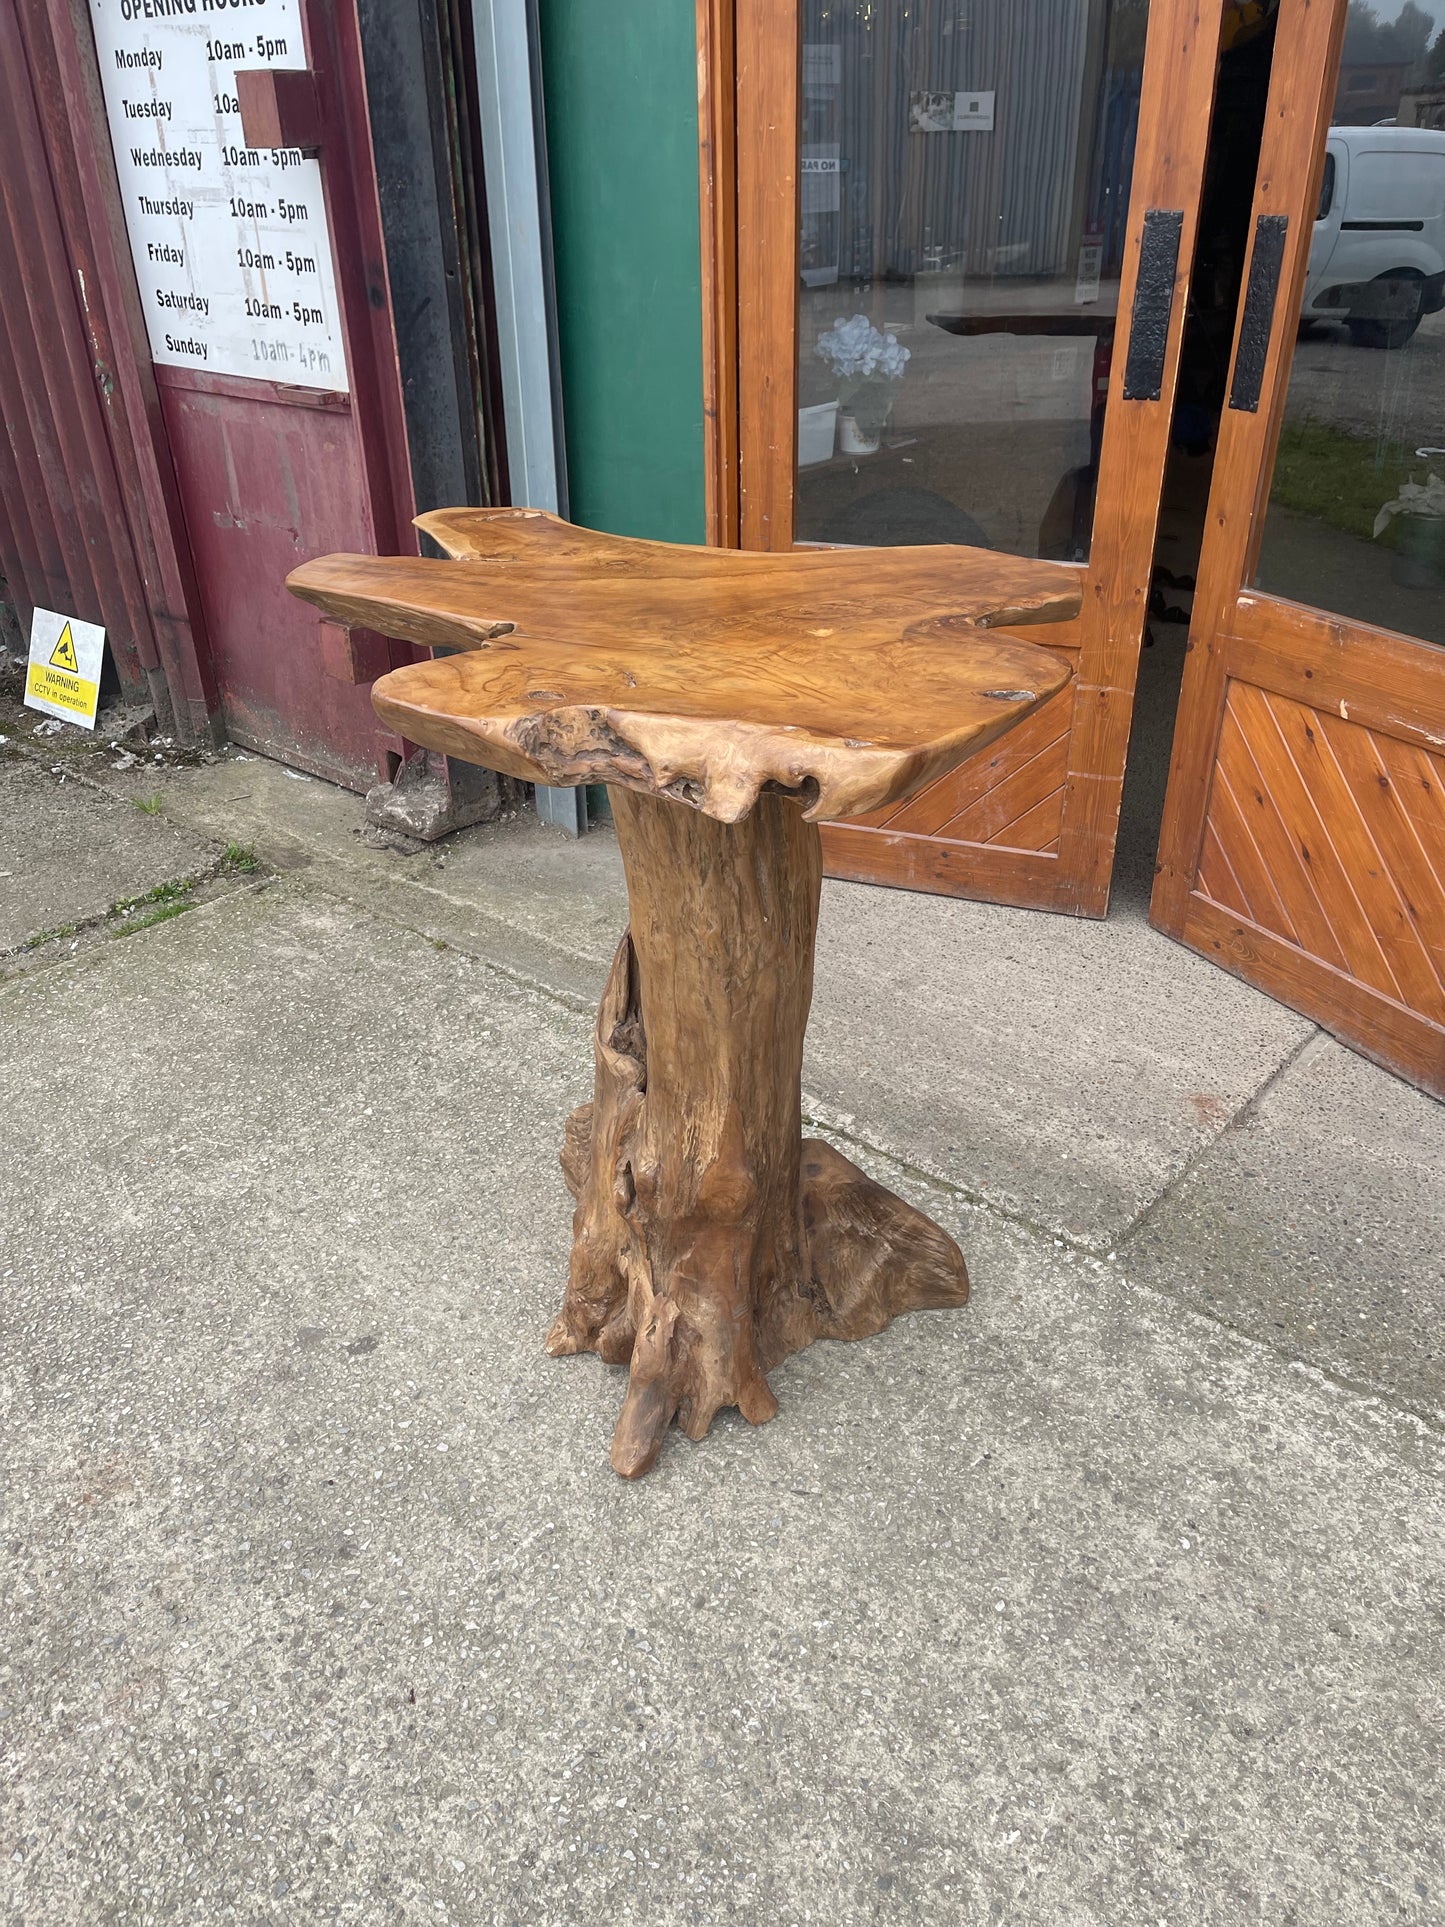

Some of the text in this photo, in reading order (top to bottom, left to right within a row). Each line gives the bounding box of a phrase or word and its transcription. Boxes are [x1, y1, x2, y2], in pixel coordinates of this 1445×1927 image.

[120, 0, 197, 21] OPENING
[114, 48, 163, 71] Monday
[206, 40, 245, 61] 10am
[256, 35, 288, 61] 5pm
[122, 92, 241, 121] Tuesday 10a
[130, 148, 203, 171] Wednesday
[222, 146, 260, 167] 10am
[271, 149, 302, 171] 5pm
[138, 196, 194, 220] Thursday
[229, 197, 268, 219] 10am
[278, 199, 309, 224] 5pm
[147, 242, 184, 268] Friday
[237, 248, 275, 270] 10am
[285, 251, 316, 276] 5pm
[156, 289, 209, 316] Saturday
[244, 298, 282, 320] 10am
[293, 302, 323, 327] 5pm
[165, 334, 208, 361] Sunday
[252, 339, 288, 361] 10am
[299, 343, 331, 373] 4pm
[34, 682, 51, 695] CCTV
[59, 693, 88, 709] operation
[45, 671, 80, 692] WARNING
